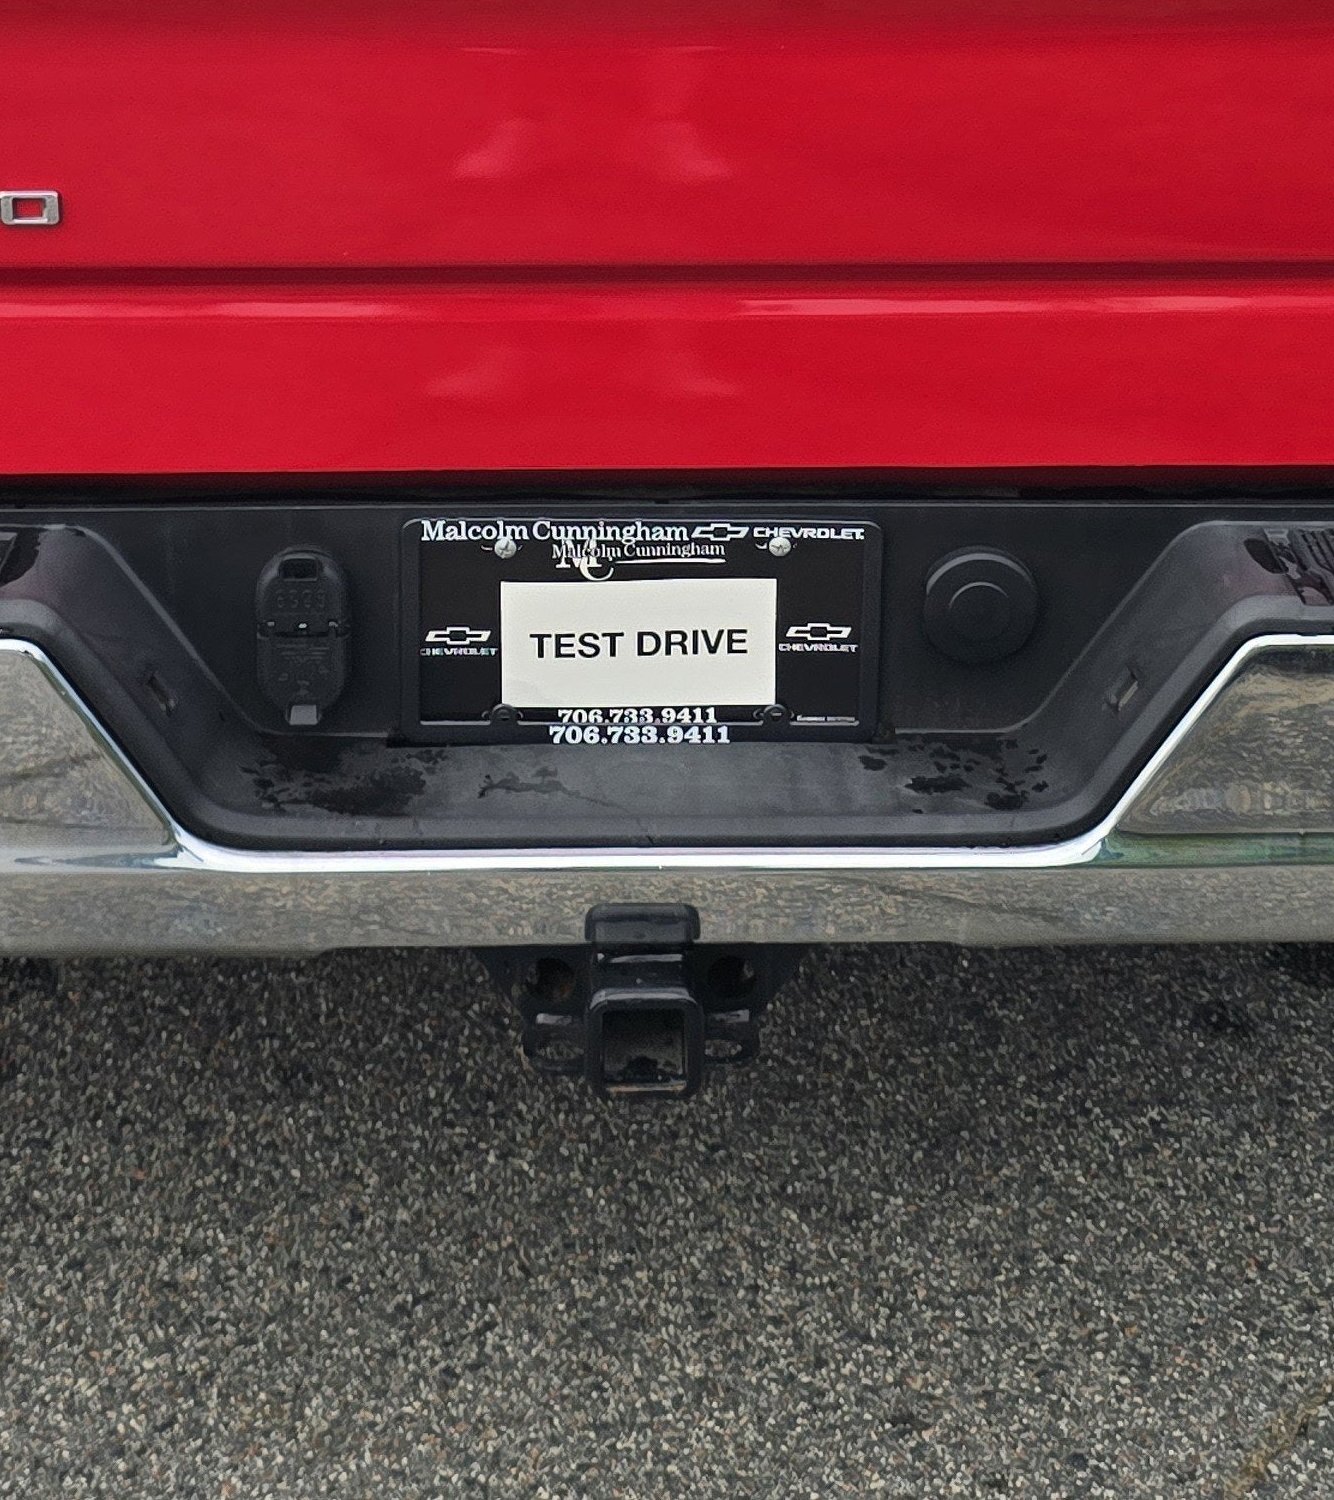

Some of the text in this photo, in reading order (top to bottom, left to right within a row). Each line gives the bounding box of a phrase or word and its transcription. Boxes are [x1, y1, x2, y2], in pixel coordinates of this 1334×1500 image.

[420, 520, 530, 542] Malcolm
[532, 520, 690, 544] Cunningham
[550, 541, 727, 560] Malcolm Cunningham
[420, 646, 499, 657] CHEVROLET
[529, 628, 749, 659] TEST DRIVE
[778, 642, 859, 653] CHEVROLET
[557, 706, 717, 724] 706.733.9411
[549, 724, 731, 745] 706.733.9411
